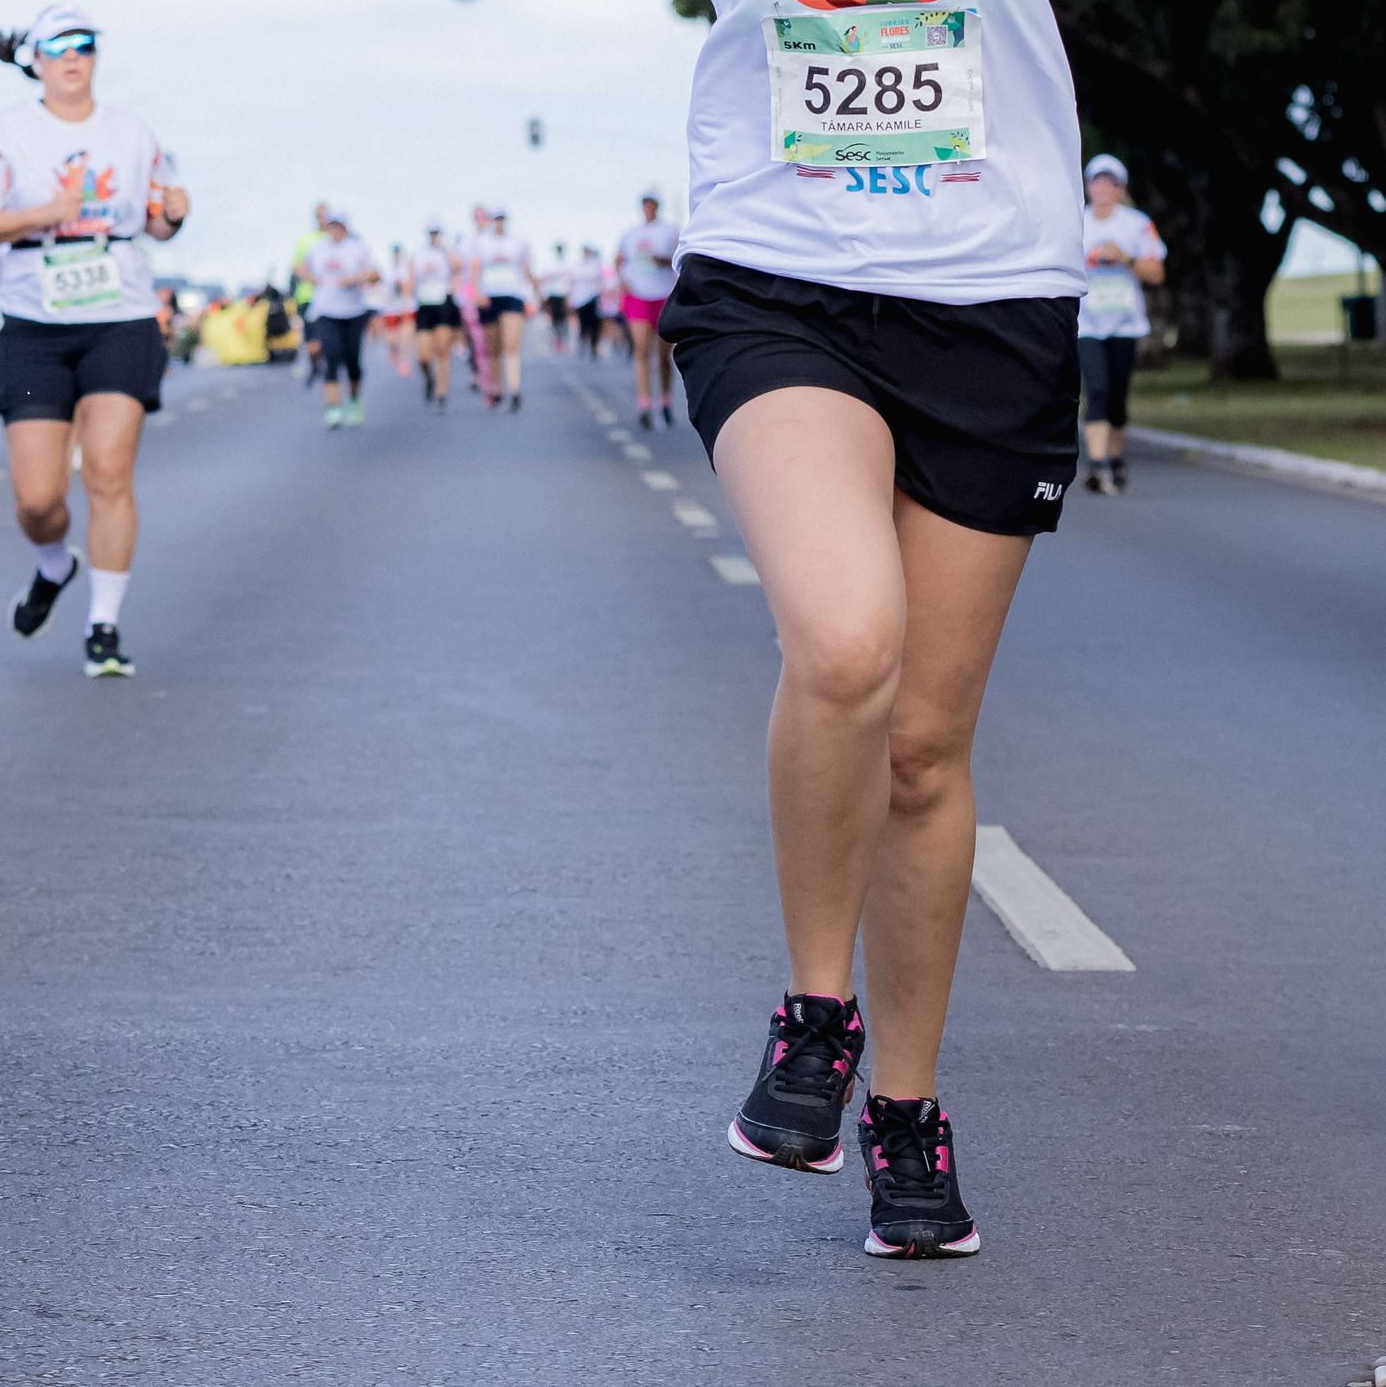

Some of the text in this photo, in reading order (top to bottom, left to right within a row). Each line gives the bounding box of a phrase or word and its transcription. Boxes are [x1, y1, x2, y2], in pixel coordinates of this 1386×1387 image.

[880, 25, 910, 37] FLORES
[783, 41, 816, 51] 5Km
[804, 62, 943, 116] 5285
[876, 119, 922, 131] KAMILE
[835, 149, 872, 162] Sesc
